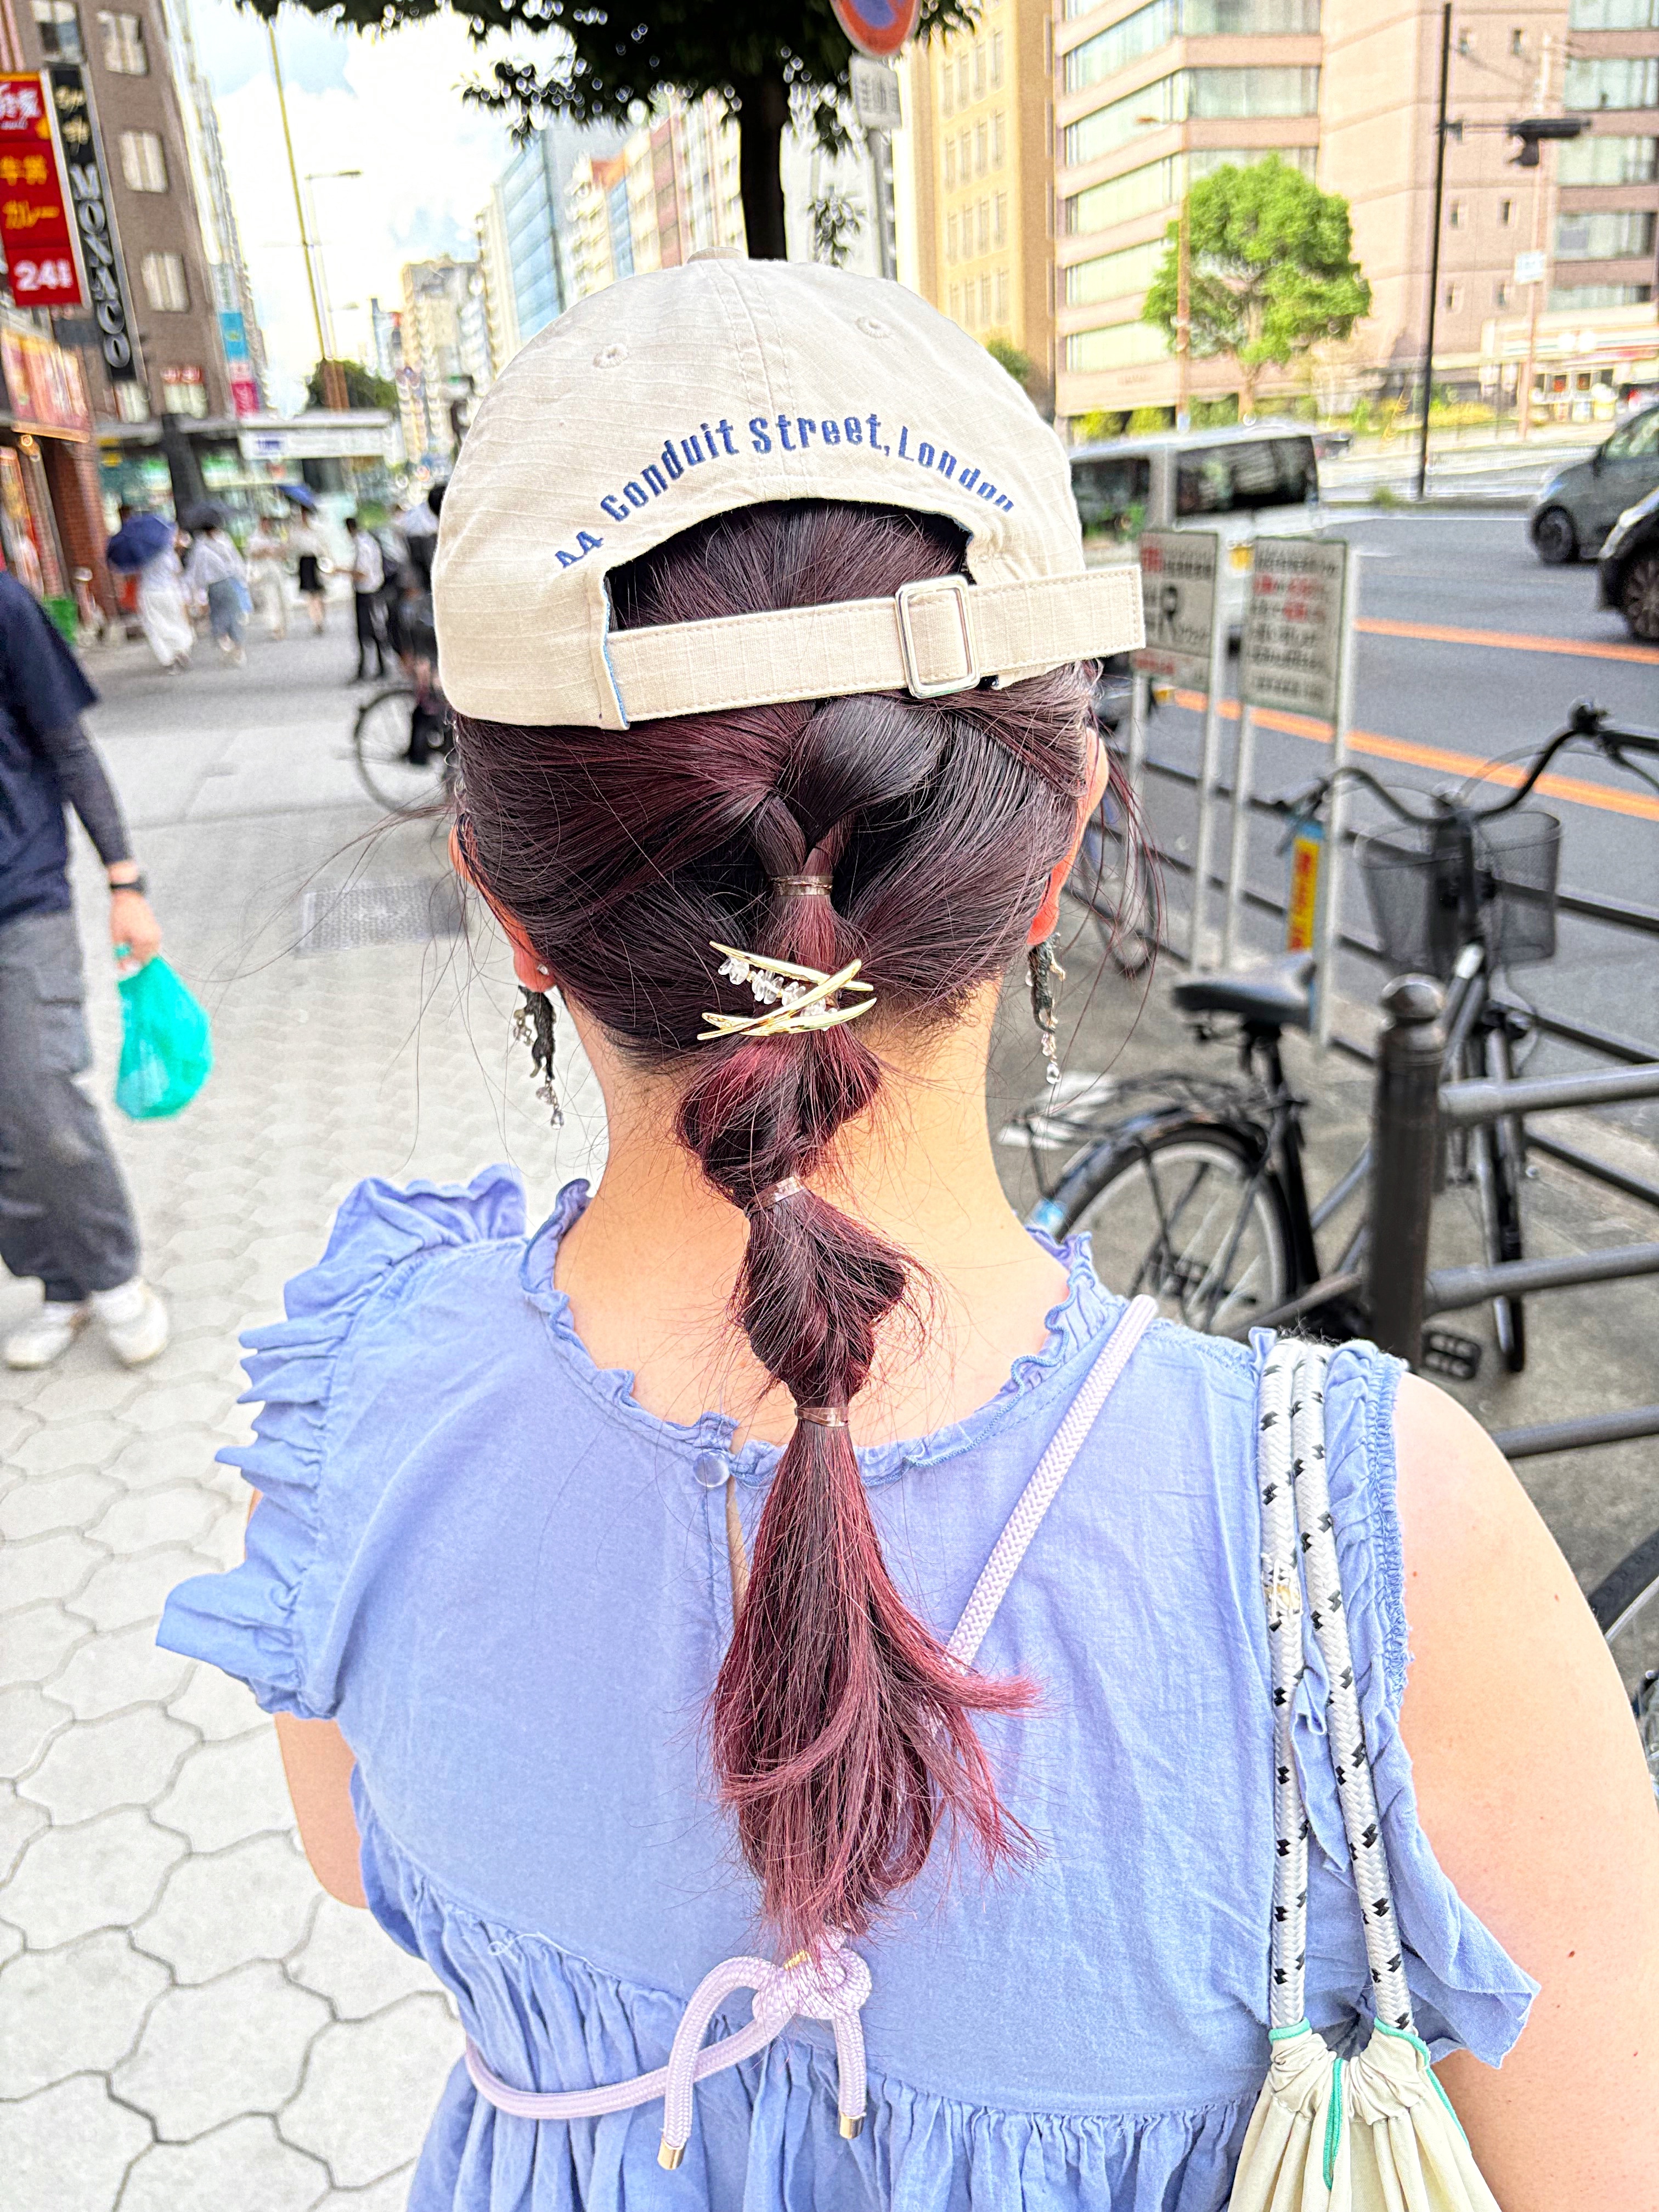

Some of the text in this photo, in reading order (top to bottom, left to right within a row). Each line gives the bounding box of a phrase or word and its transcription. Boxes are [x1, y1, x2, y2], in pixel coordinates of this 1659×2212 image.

[2, 199, 60, 229] カレー
[69, 165, 131, 368] MONACO
[600, 419, 739, 522] Conduit
[748, 414, 891, 457] Street,
[898, 426, 1014, 512] London
